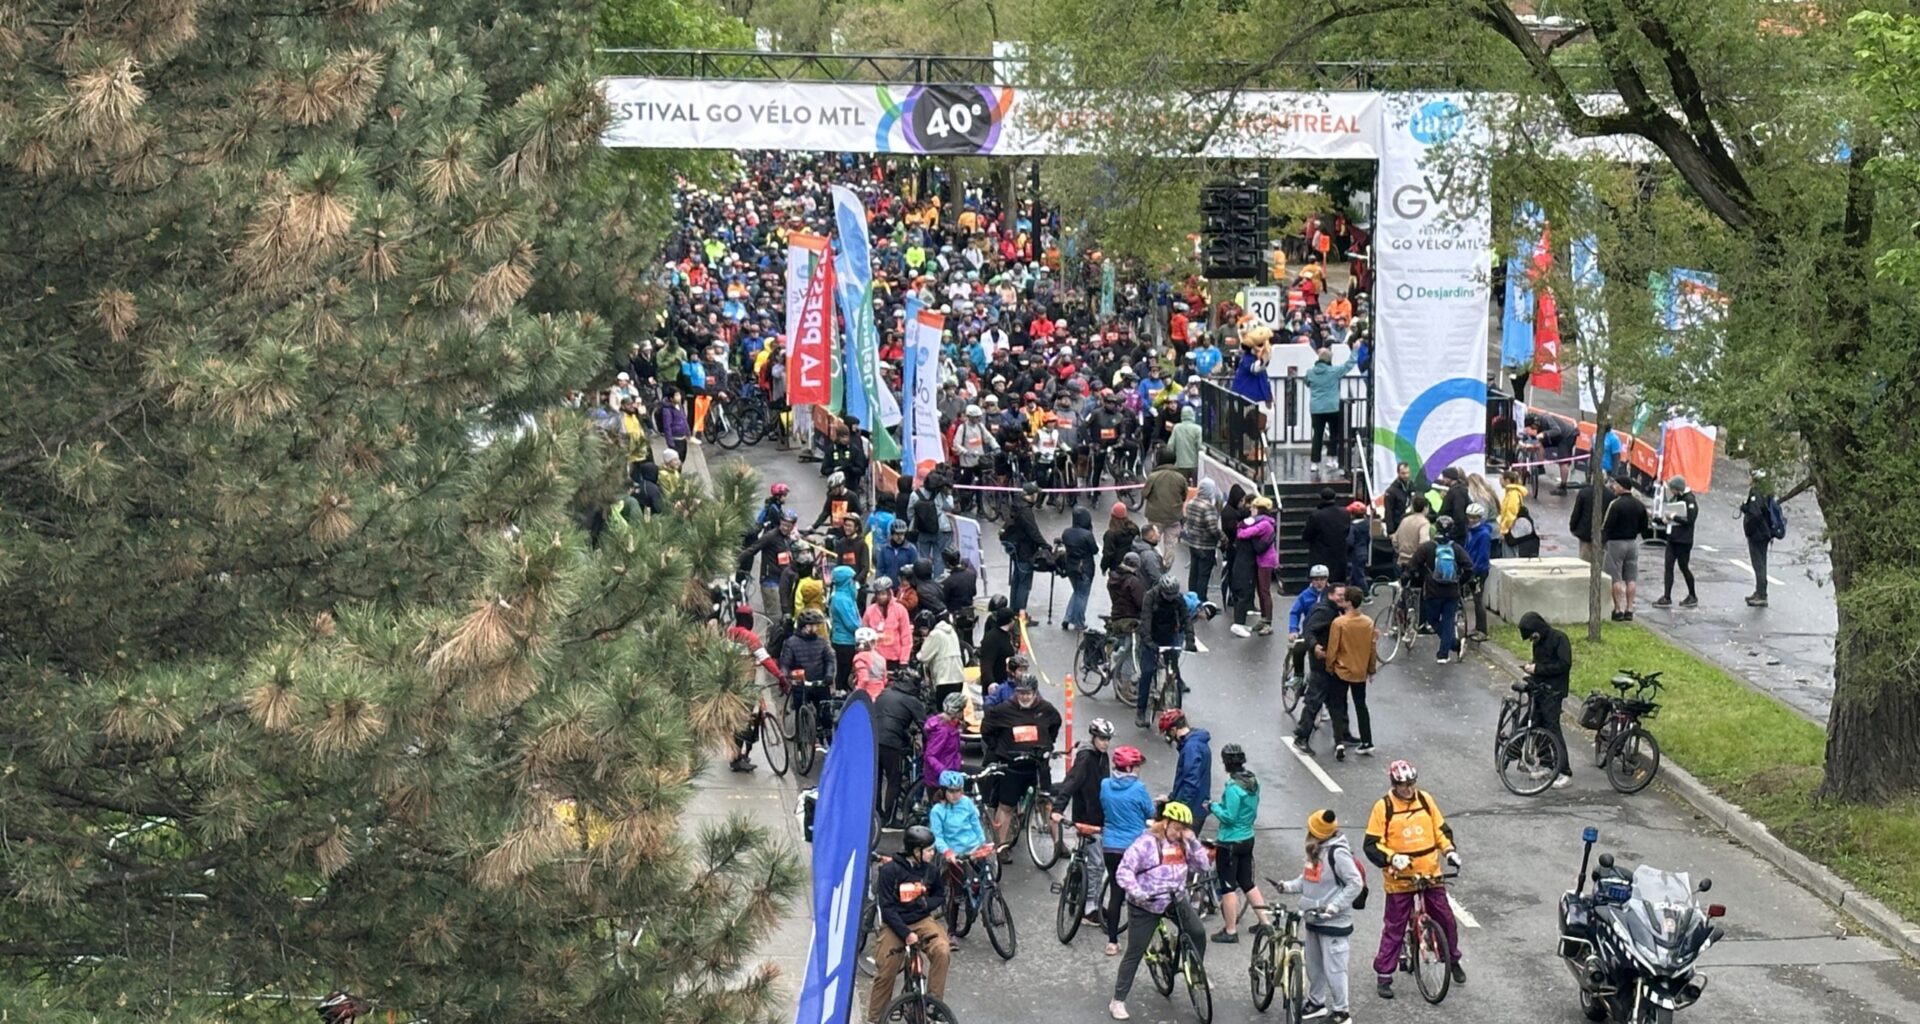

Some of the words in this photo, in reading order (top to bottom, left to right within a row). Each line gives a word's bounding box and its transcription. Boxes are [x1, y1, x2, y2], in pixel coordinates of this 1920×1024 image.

[607, 102, 700, 121] ESTIVAL
[706, 104, 742, 122] GO
[748, 99, 812, 124] VÉLO
[819, 106, 865, 126] MTL
[1391, 239, 1413, 250] GO
[1455, 239, 1480, 250] MTL
[1417, 286, 1475, 300] Desjardins
[1251, 301, 1276, 323] 30
